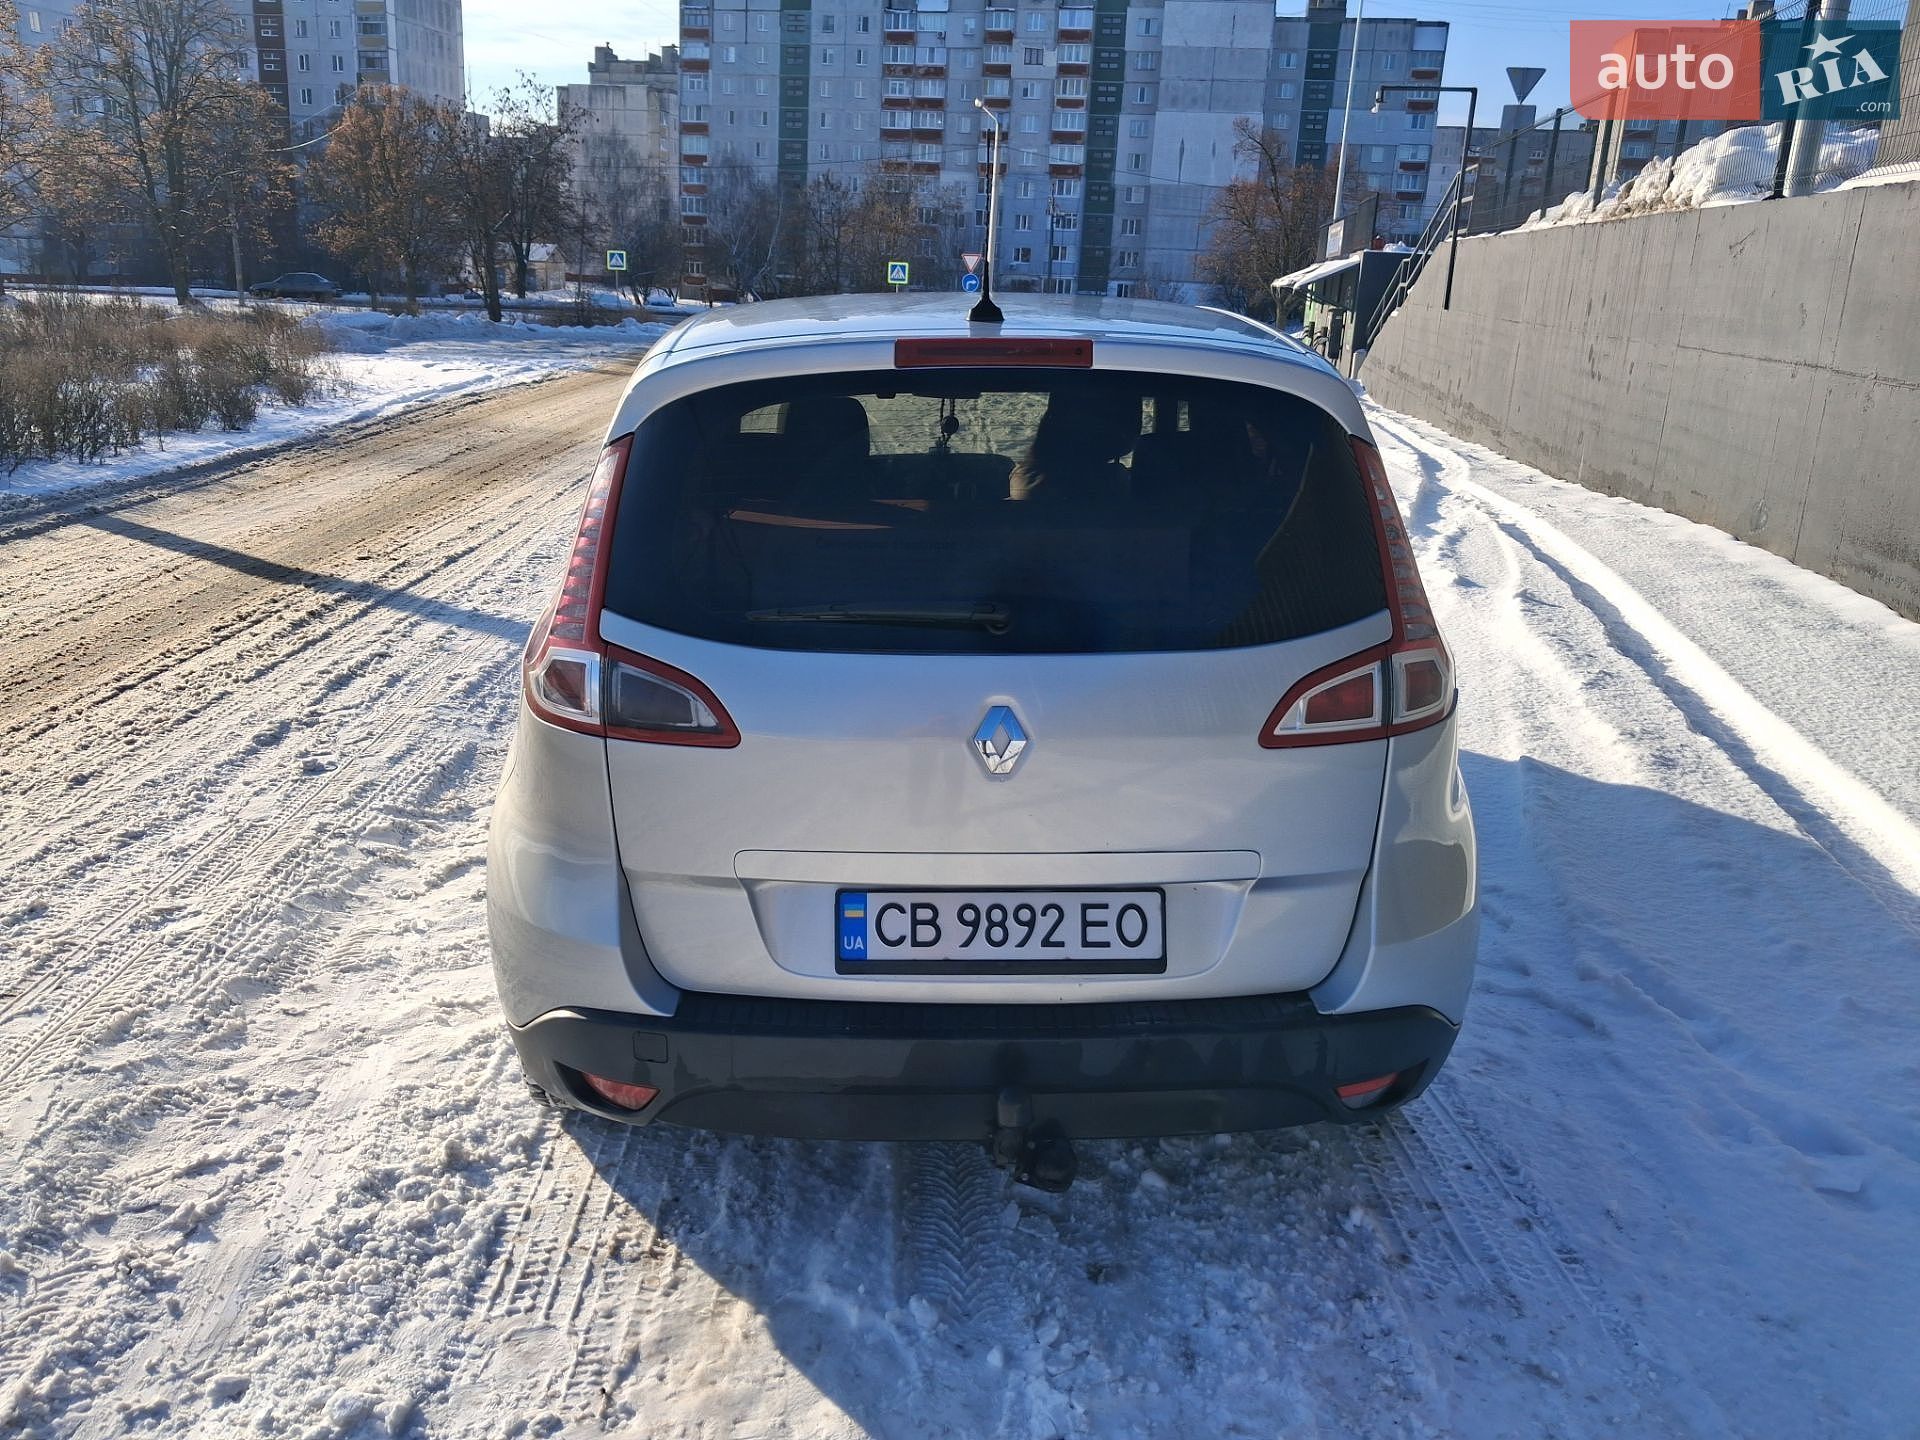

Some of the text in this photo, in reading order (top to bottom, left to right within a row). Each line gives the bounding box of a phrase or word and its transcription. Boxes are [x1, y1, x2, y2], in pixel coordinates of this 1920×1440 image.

[874, 902, 1148, 948] CB 9892 EO
[844, 935, 864, 950] UA
